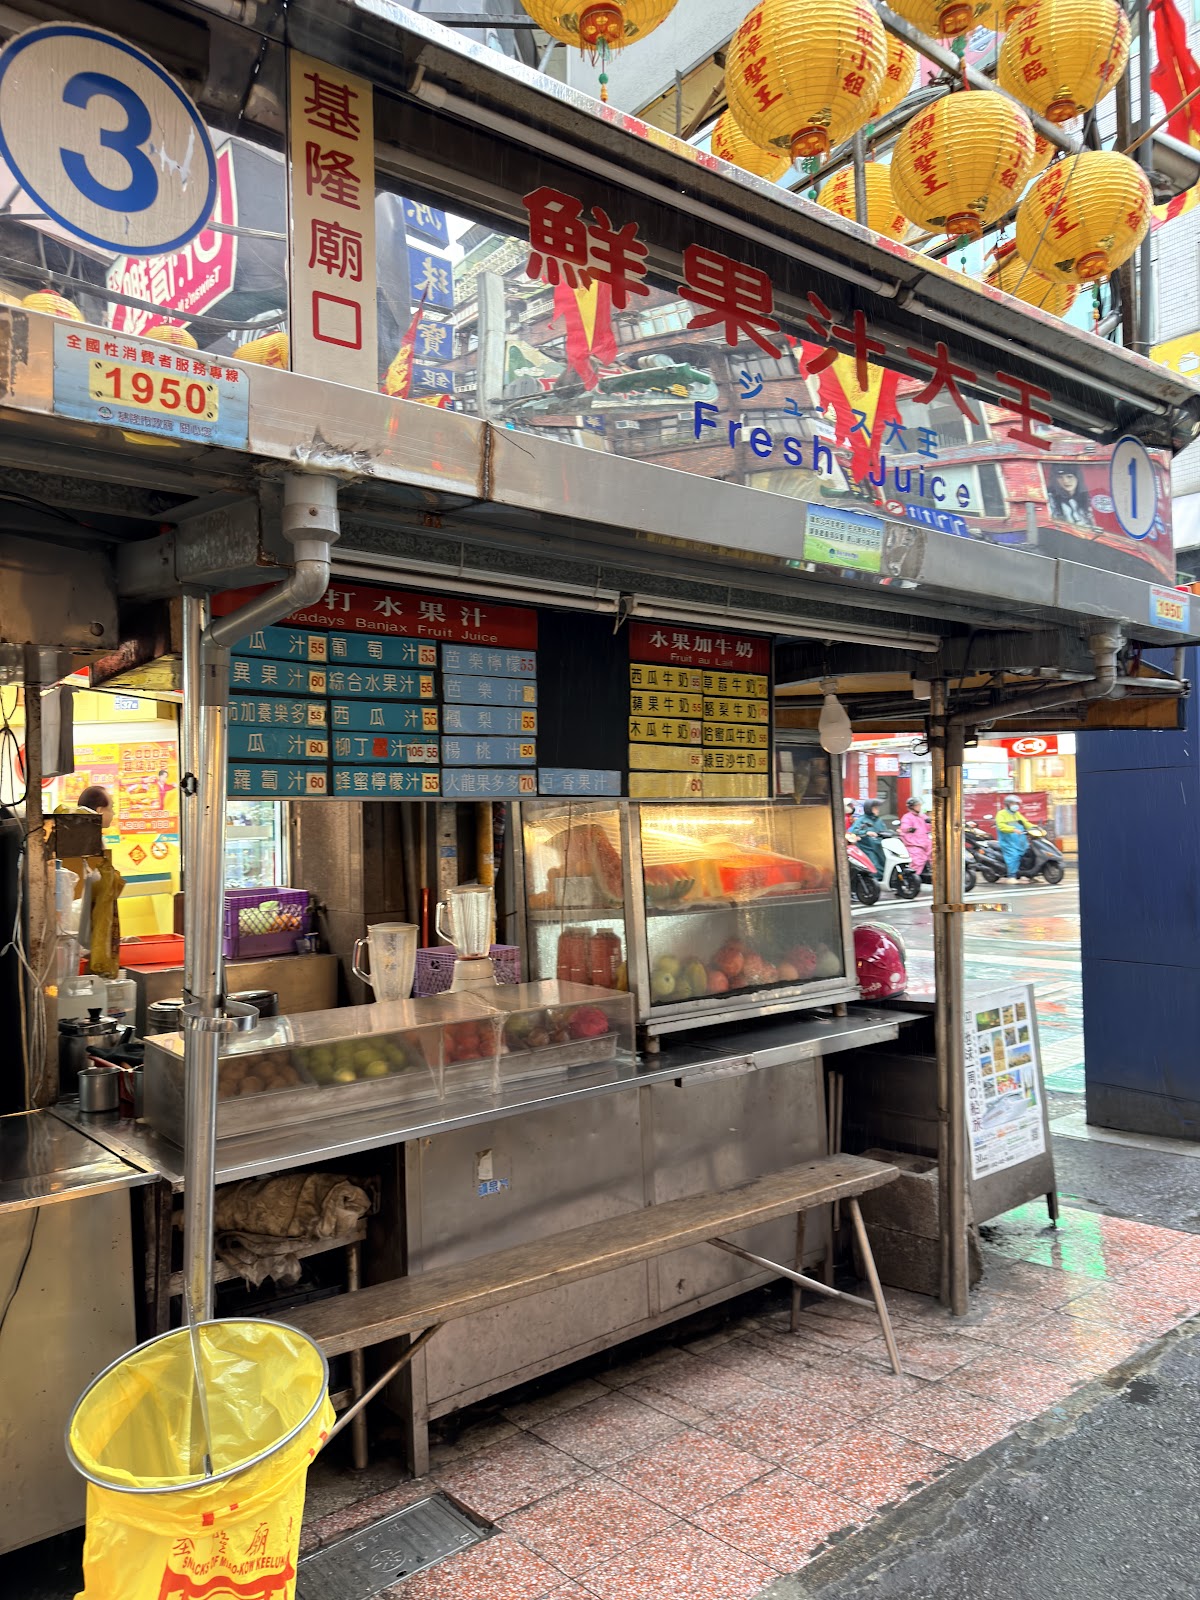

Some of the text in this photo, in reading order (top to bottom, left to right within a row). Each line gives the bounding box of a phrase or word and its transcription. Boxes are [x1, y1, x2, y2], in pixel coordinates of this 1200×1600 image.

[60, 71, 158, 213] 3
[303, 72, 365, 351] 基隆廟口
[523, 185, 1052, 452] 鮮果汁大王
[67, 334, 240, 383] 全國性消費者服務專線
[105, 367, 206, 414] 1950
[738, 369, 939, 459] ジュース大王
[694, 400, 972, 508] Fresh Juice
[1128, 457, 1138, 519] 1
[325, 588, 488, 627] 打水果汁
[287, 612, 498, 643] wadays Banjax Fruit Juice
[248, 630, 325, 655] 瓜汁 55
[331, 637, 435, 663] 葡萄汁 55
[648, 631, 754, 659] 水果加牛奶
[520, 658, 535, 672] 55
[670, 652, 693, 663] Fruit
[715, 658, 733, 667] Lait
[233, 661, 325, 689] 異果汁 60
[328, 672, 433, 694] 綜合水果汁 55
[631, 668, 688, 688] 西瓜牛奶
[703, 675, 756, 694] 草莓牛奶
[447, 679, 522, 701] 芭樂汁
[310, 711, 322, 720] 55
[632, 696, 701, 713] 蘋果牛奶 55
[334, 705, 437, 728] 西瓜汁 55
[446, 709, 535, 731] 鳳梨汁 55
[630, 721, 701, 740] 木瓜牛奶 60
[703, 727, 756, 744] 哈蜜瓜牛奶
[247, 733, 324, 755] 瓜汁 60
[335, 737, 406, 758] 柳丁汁
[426, 747, 438, 758] 55
[445, 741, 520, 760] 楊桃汁
[691, 755, 700, 765] 55
[704, 753, 756, 769] 綠豆沙牛奶
[233, 769, 324, 791] 蘿蔔汁 60
[335, 771, 439, 791] 蜂蜜檸檬汁 55
[445, 774, 534, 793] 火龍果多多 70
[691, 779, 702, 791] 60
[182, 1556, 209, 1575] SNACKS
[255, 1556, 286, 1570] KEELUN
